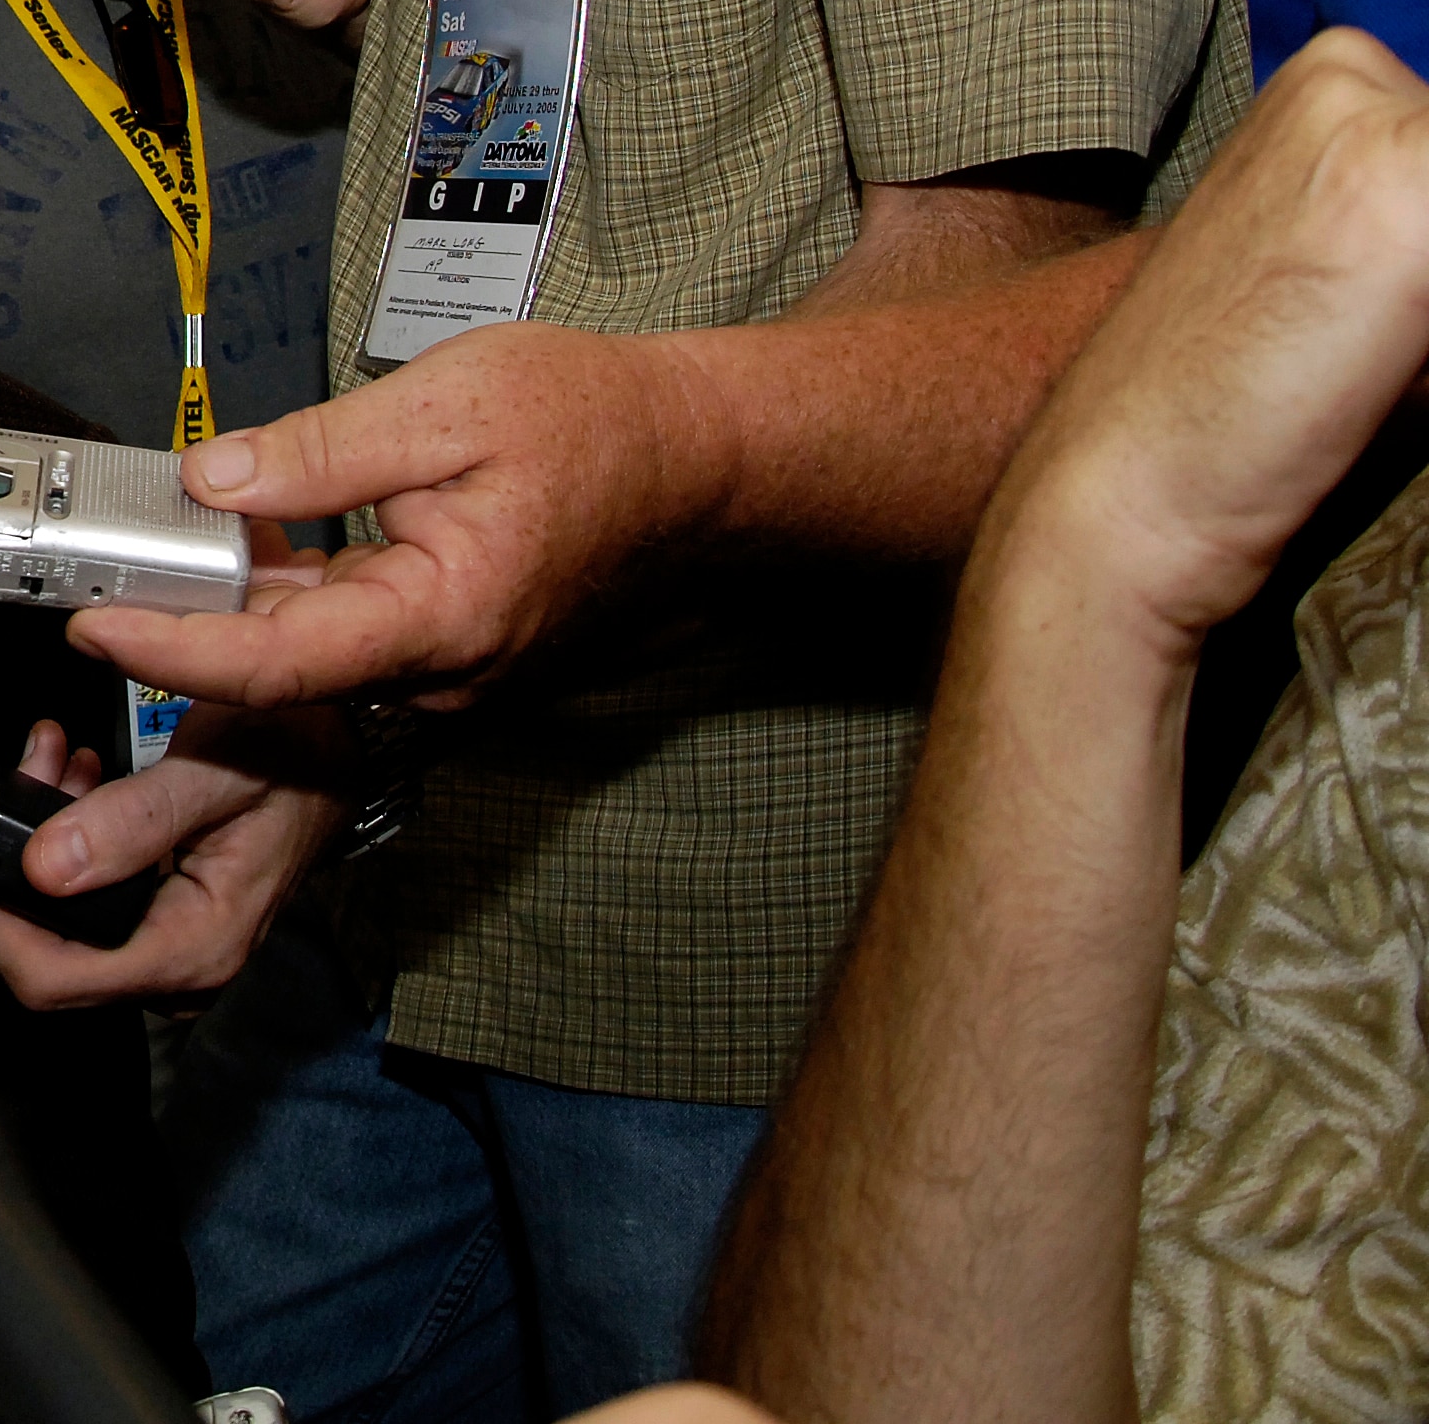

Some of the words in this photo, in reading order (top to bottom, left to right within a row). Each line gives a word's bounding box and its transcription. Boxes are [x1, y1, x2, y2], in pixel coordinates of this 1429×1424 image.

[23, 0, 73, 60] Series
[440, 11, 467, 33] Sat
[503, 86, 528, 98] JUNE
[529, 86, 541, 97] 29
[542, 85, 560, 97] thru
[502, 102, 524, 114] JULY
[526, 103, 535, 115] 2,
[535, 101, 558, 114] 2005
[109, 105, 176, 194] NASCAR
[483, 141, 547, 162] DAYTONA
